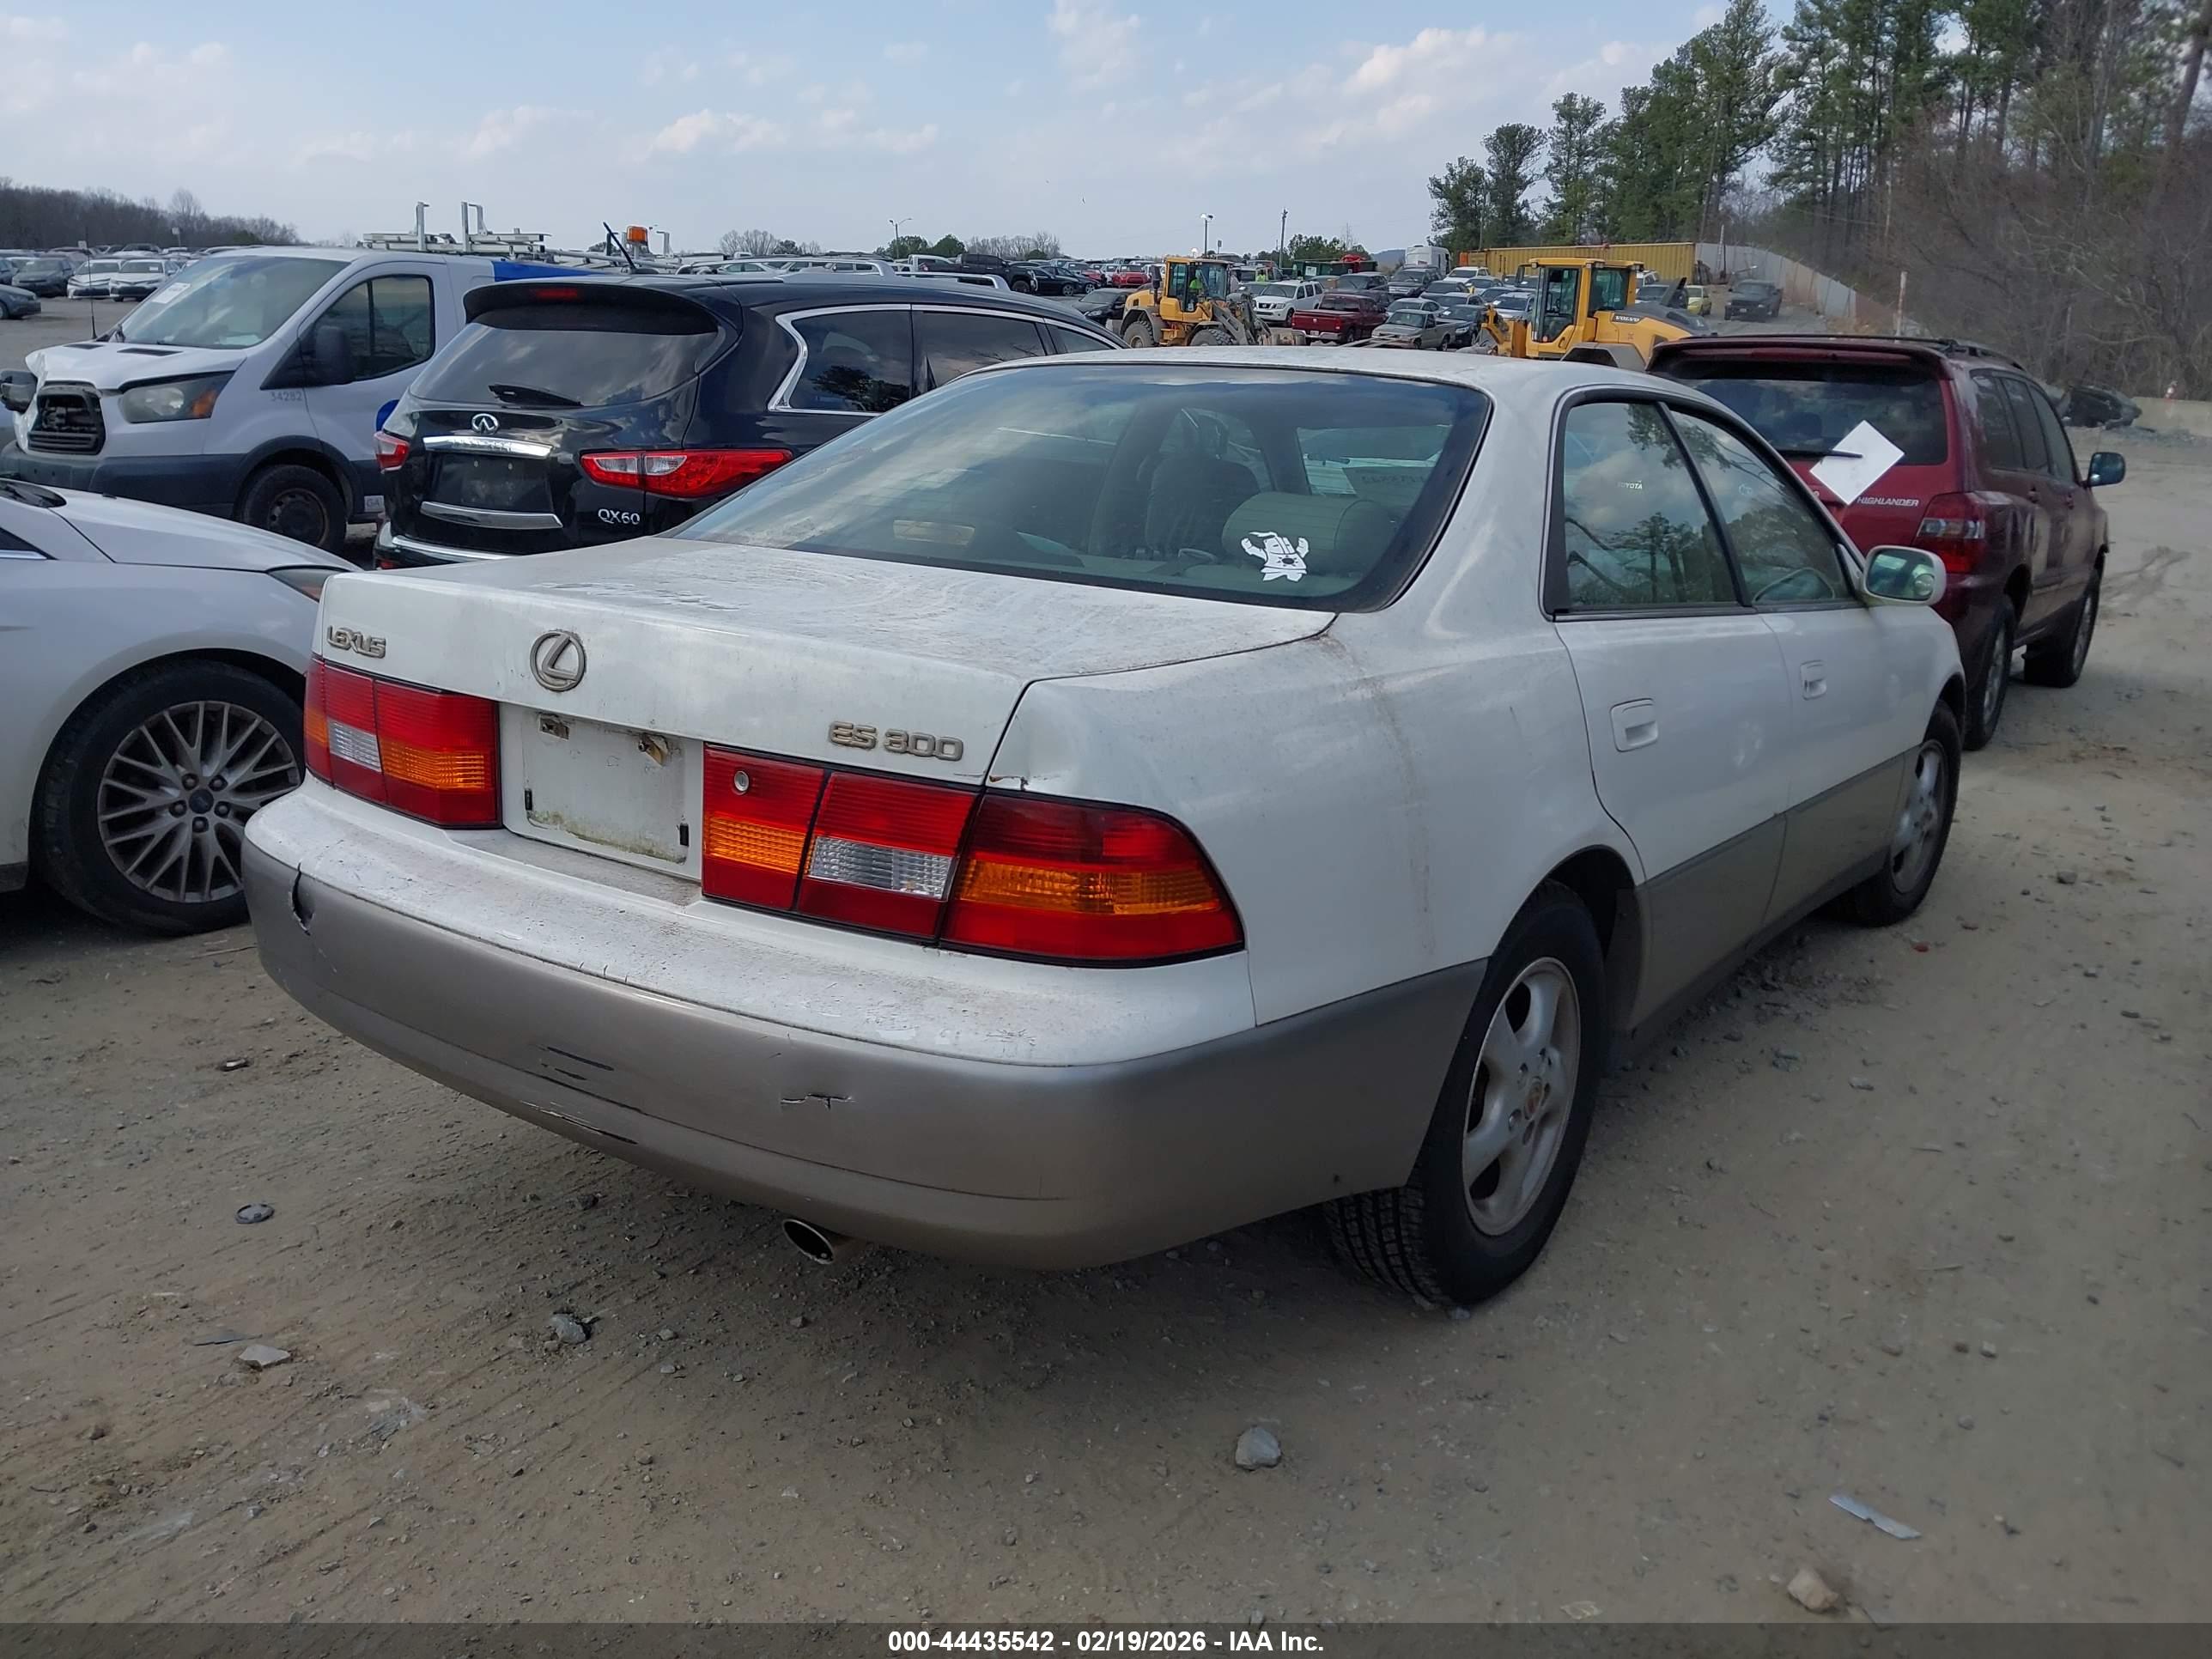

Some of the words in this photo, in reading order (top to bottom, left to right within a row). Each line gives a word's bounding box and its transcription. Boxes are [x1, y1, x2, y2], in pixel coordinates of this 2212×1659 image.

[1856, 496, 1920, 507] HIGHLANDER
[598, 508, 641, 525] QX60
[326, 624, 386, 659] LEXUS
[829, 720, 877, 750] ES
[883, 727, 963, 762] 300
